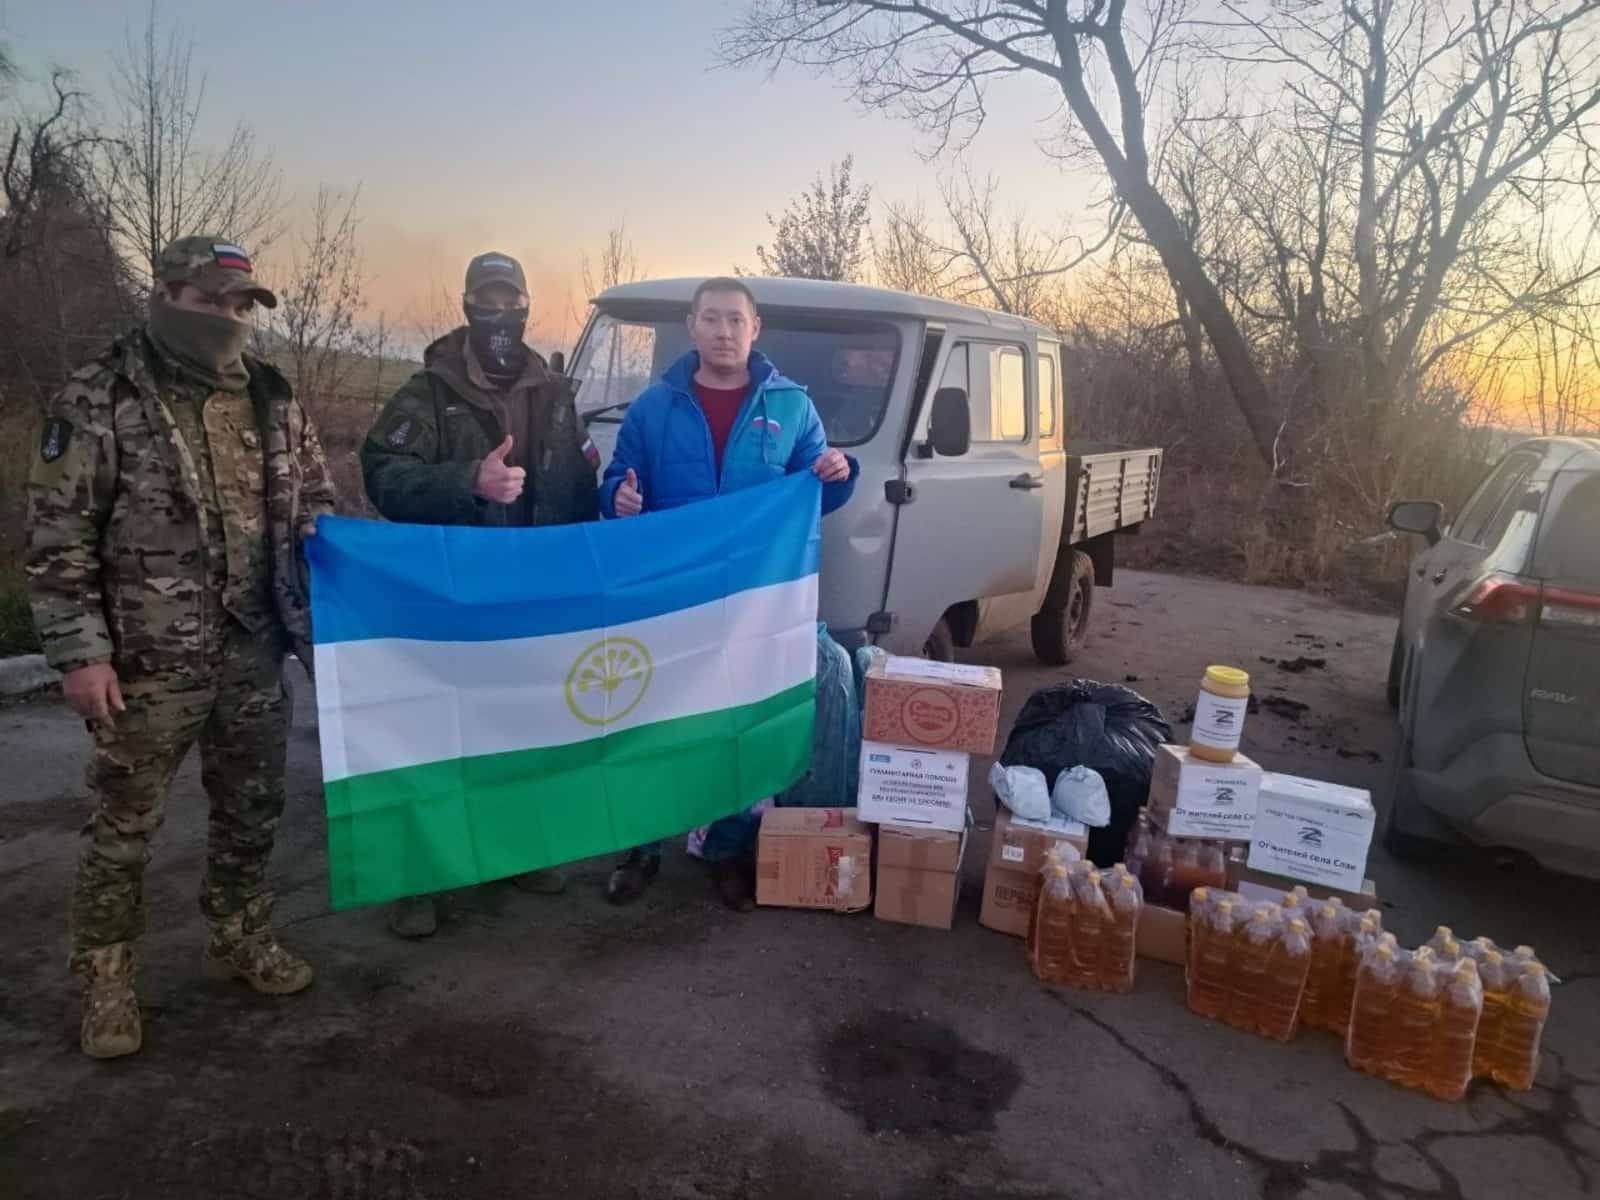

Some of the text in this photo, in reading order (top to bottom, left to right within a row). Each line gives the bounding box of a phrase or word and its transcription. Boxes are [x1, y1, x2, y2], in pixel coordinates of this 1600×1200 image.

[1258, 840, 1269, 849] От
[1270, 845, 1309, 859] жителей
[1309, 852, 1331, 865] села
